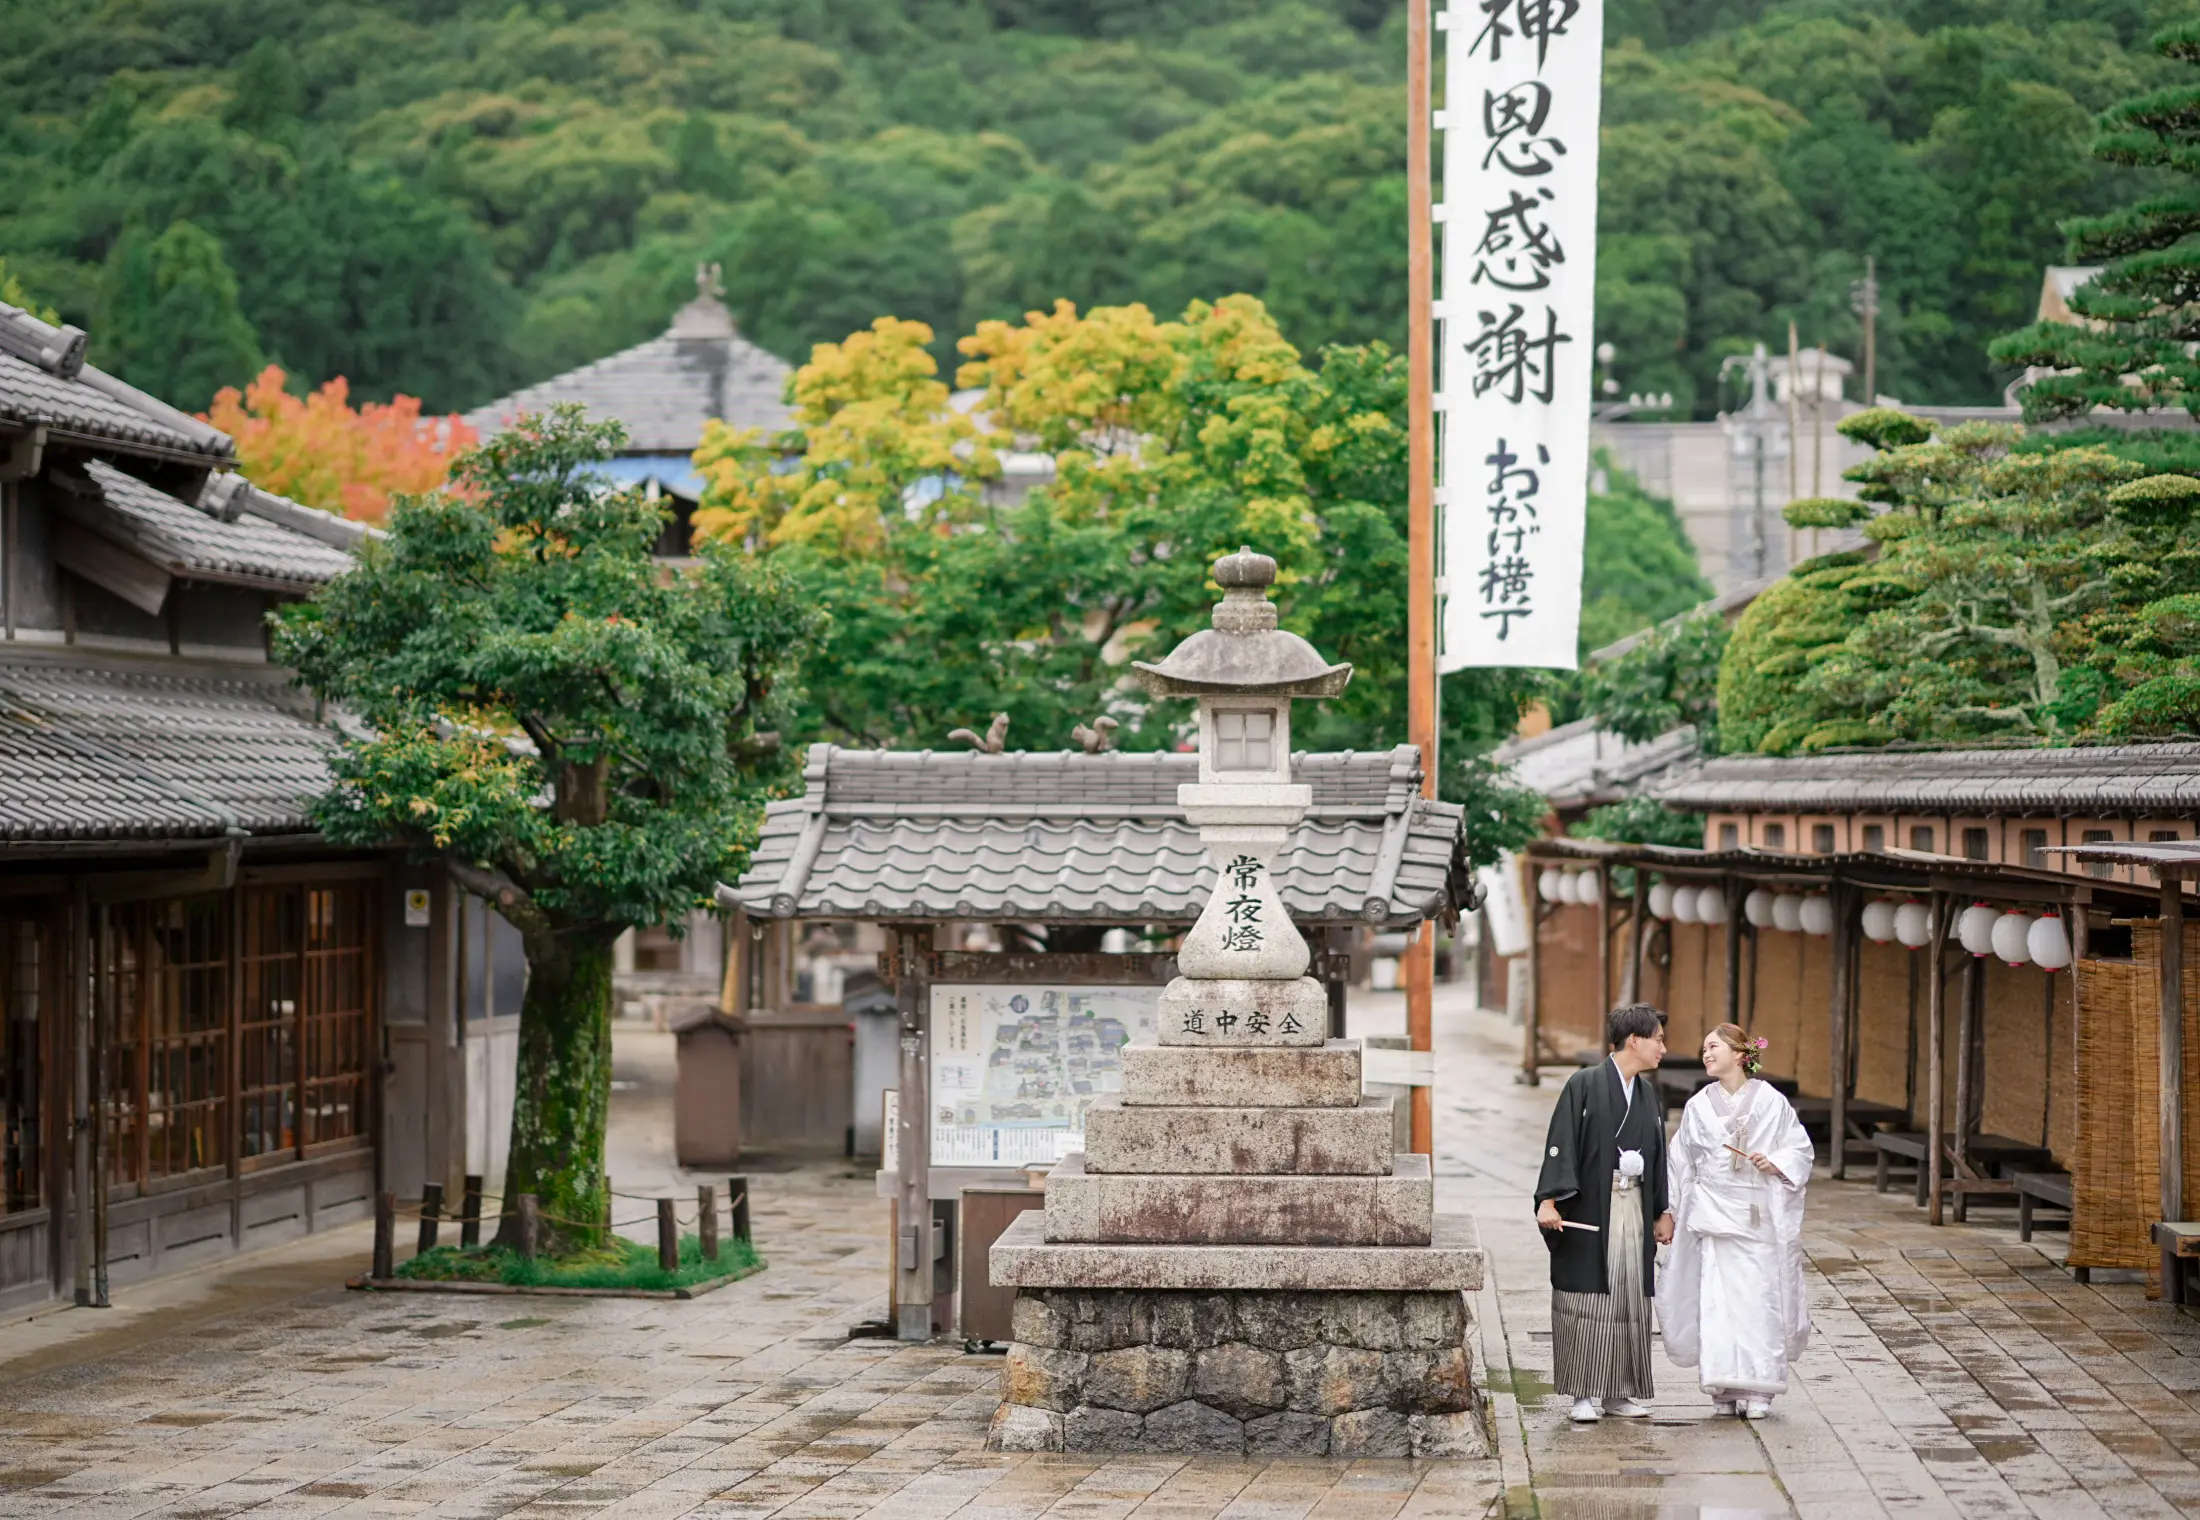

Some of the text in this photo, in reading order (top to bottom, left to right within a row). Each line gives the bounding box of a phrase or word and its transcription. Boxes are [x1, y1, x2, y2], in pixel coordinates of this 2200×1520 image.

[1463, 0, 1580, 406] 神恩感謝
[1479, 437, 1550, 641] おかげ横丁
[1221, 854, 1265, 952] 常夜燈
[1181, 1010, 1303, 1035] 道中安全
